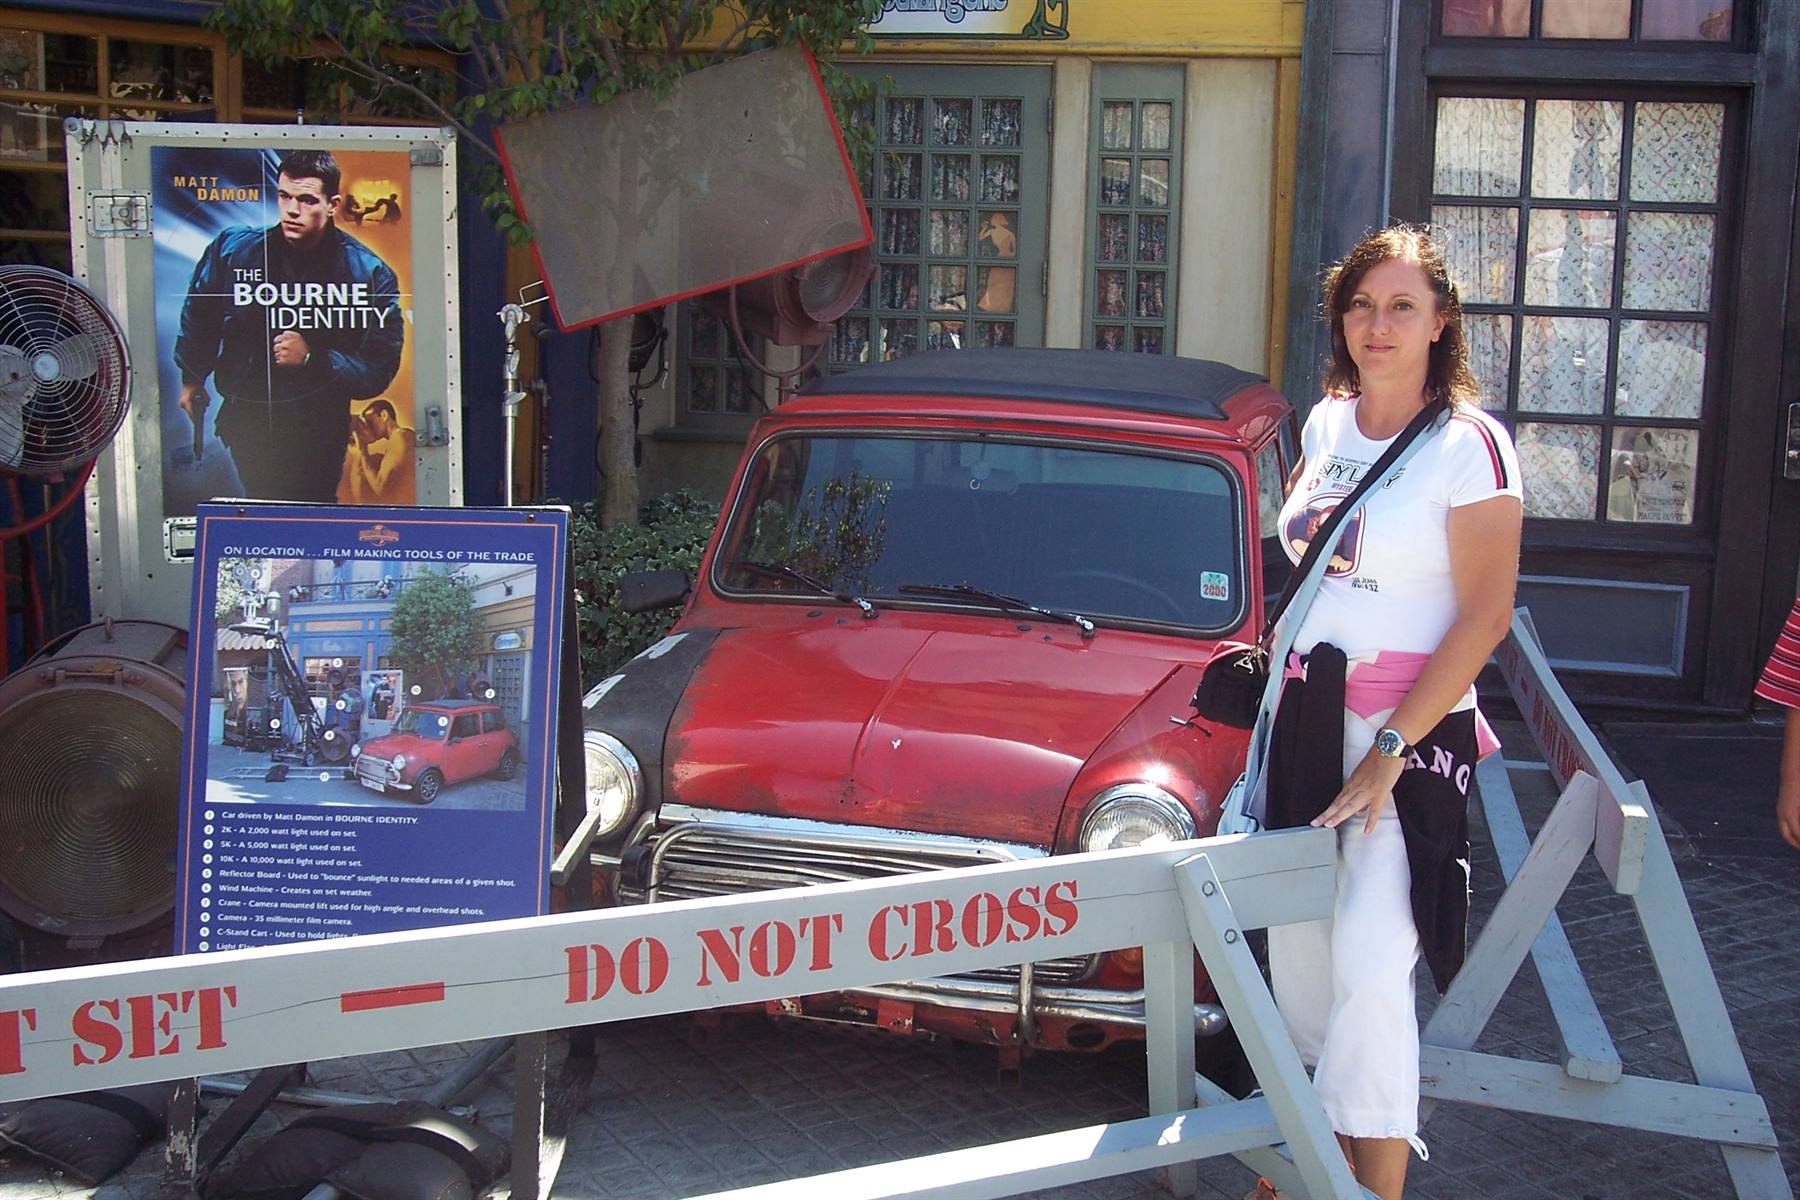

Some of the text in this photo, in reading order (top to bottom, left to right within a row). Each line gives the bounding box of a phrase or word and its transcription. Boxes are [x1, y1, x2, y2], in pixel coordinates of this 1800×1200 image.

[174, 176, 219, 187] MATT
[197, 188, 259, 201] DAMON
[233, 269, 262, 282] THE
[233, 283, 369, 306] BOURNE
[270, 307, 390, 329] IDENTITY
[224, 546, 242, 555] ON
[245, 547, 304, 556] LOCATION
[324, 548, 351, 558] FILM
[354, 548, 401, 559] MAKING
[405, 550, 444, 560] TOOLS
[447, 551, 464, 560] OF
[467, 551, 491, 561] THE
[494, 552, 535, 561] TRADE
[1203, 584, 1226, 597] 2000
[222, 811, 236, 819] Car
[237, 811, 261, 819] driven
[263, 812, 273, 821] by
[295, 813, 323, 821] Damon
[325, 814, 333, 822] in
[335, 815, 374, 823] BOURNE
[376, 816, 419, 824] IDENTITY.
[239, 826, 246, 834] A
[248, 827, 270, 835] 2,000
[291, 828, 308, 837] light
[310, 829, 329, 837] used
[238, 841, 245, 849] A
[290, 842, 308, 852] light
[220, 855, 234, 863] 10K
[250, 856, 275, 865] 10,000
[296, 857, 314, 867] light
[220, 869, 255, 878] Reflector
[257, 871, 281, 879] Board
[288, 872, 308, 880] Used
[320, 873, 356, 881] "bounce"
[357, 874, 389, 884] sunlight
[401, 876, 430, 884] needed
[455, 877, 465, 885] of
[473, 878, 495, 888] given
[496, 878, 517, 887] shot.
[219, 884, 240, 892] Wind
[241, 885, 274, 893] Machine
[281, 886, 311, 895] Creates
[340, 889, 373, 897] weather.
[218, 899, 241, 907] Crane
[248, 900, 279, 908] Camera
[280, 902, 315, 910] mounted
[316, 902, 328, 910] lift
[329, 903, 349, 911] used
[350, 903, 362, 911] for
[363, 904, 381, 913] high
[382, 905, 404, 914] angle
[422, 906, 460, 915] overhead
[460, 907, 485, 915] shots.
[217, 913, 248, 922] Camera
[255, 914, 265, 922] 35
[266, 915, 305, 924] millimeter
[306, 916, 321, 924] film
[323, 918, 353, 926] camera.
[217, 928, 249, 937] C-Stand
[251, 929, 268, 937] Cart
[275, 930, 296, 938] Used
[297, 931, 306, 939] to
[307, 931, 325, 939] hold
[216, 943, 236, 951] Light
[71, 985, 237, 1067] SET
[564, 936, 670, 1005] DO
[696, 912, 844, 987] NOT
[867, 879, 1080, 965] CROSS
